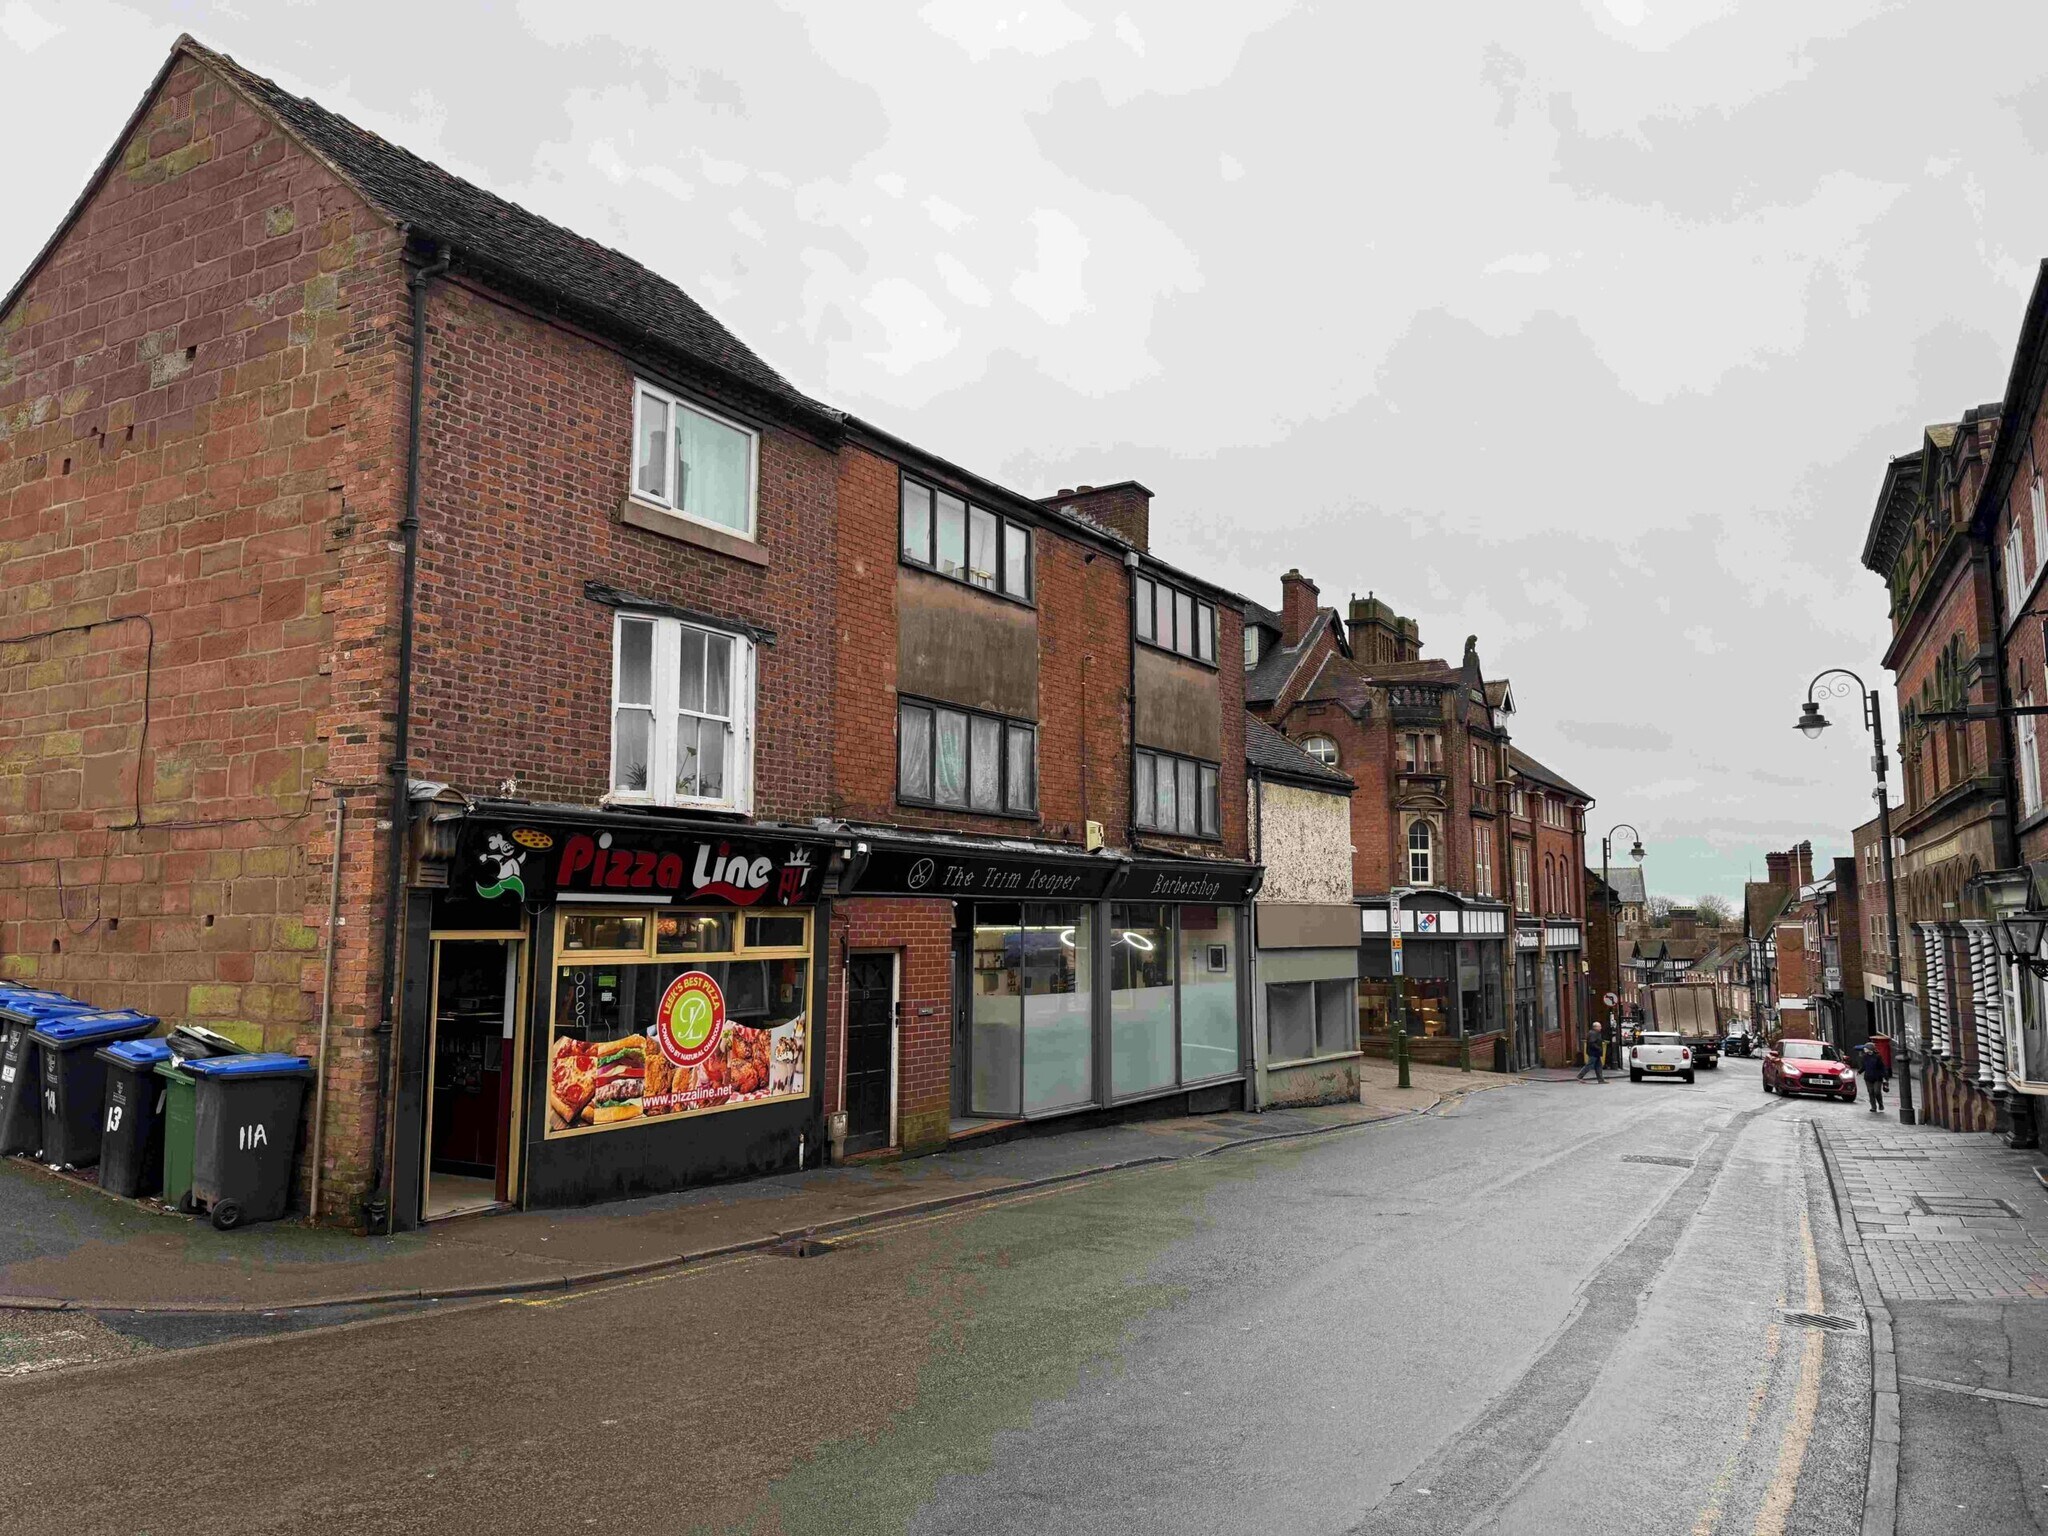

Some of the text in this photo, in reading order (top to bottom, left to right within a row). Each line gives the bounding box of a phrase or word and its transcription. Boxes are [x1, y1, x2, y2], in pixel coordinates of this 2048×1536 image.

[556, 832, 773, 889] Pizza Line
[943, 866, 1081, 895] The Trim Reaper
[1150, 872, 1220, 901] Barbershop
[664, 976, 721, 1015] LEEK'S BEST PIZZA
[661, 1019, 721, 1061] POWERED BY NATURAL CHARCOAL
[643, 1084, 732, 1107] www.pizzaline.net
[106, 1105, 123, 1132] 13
[239, 1123, 268, 1151] 11A
